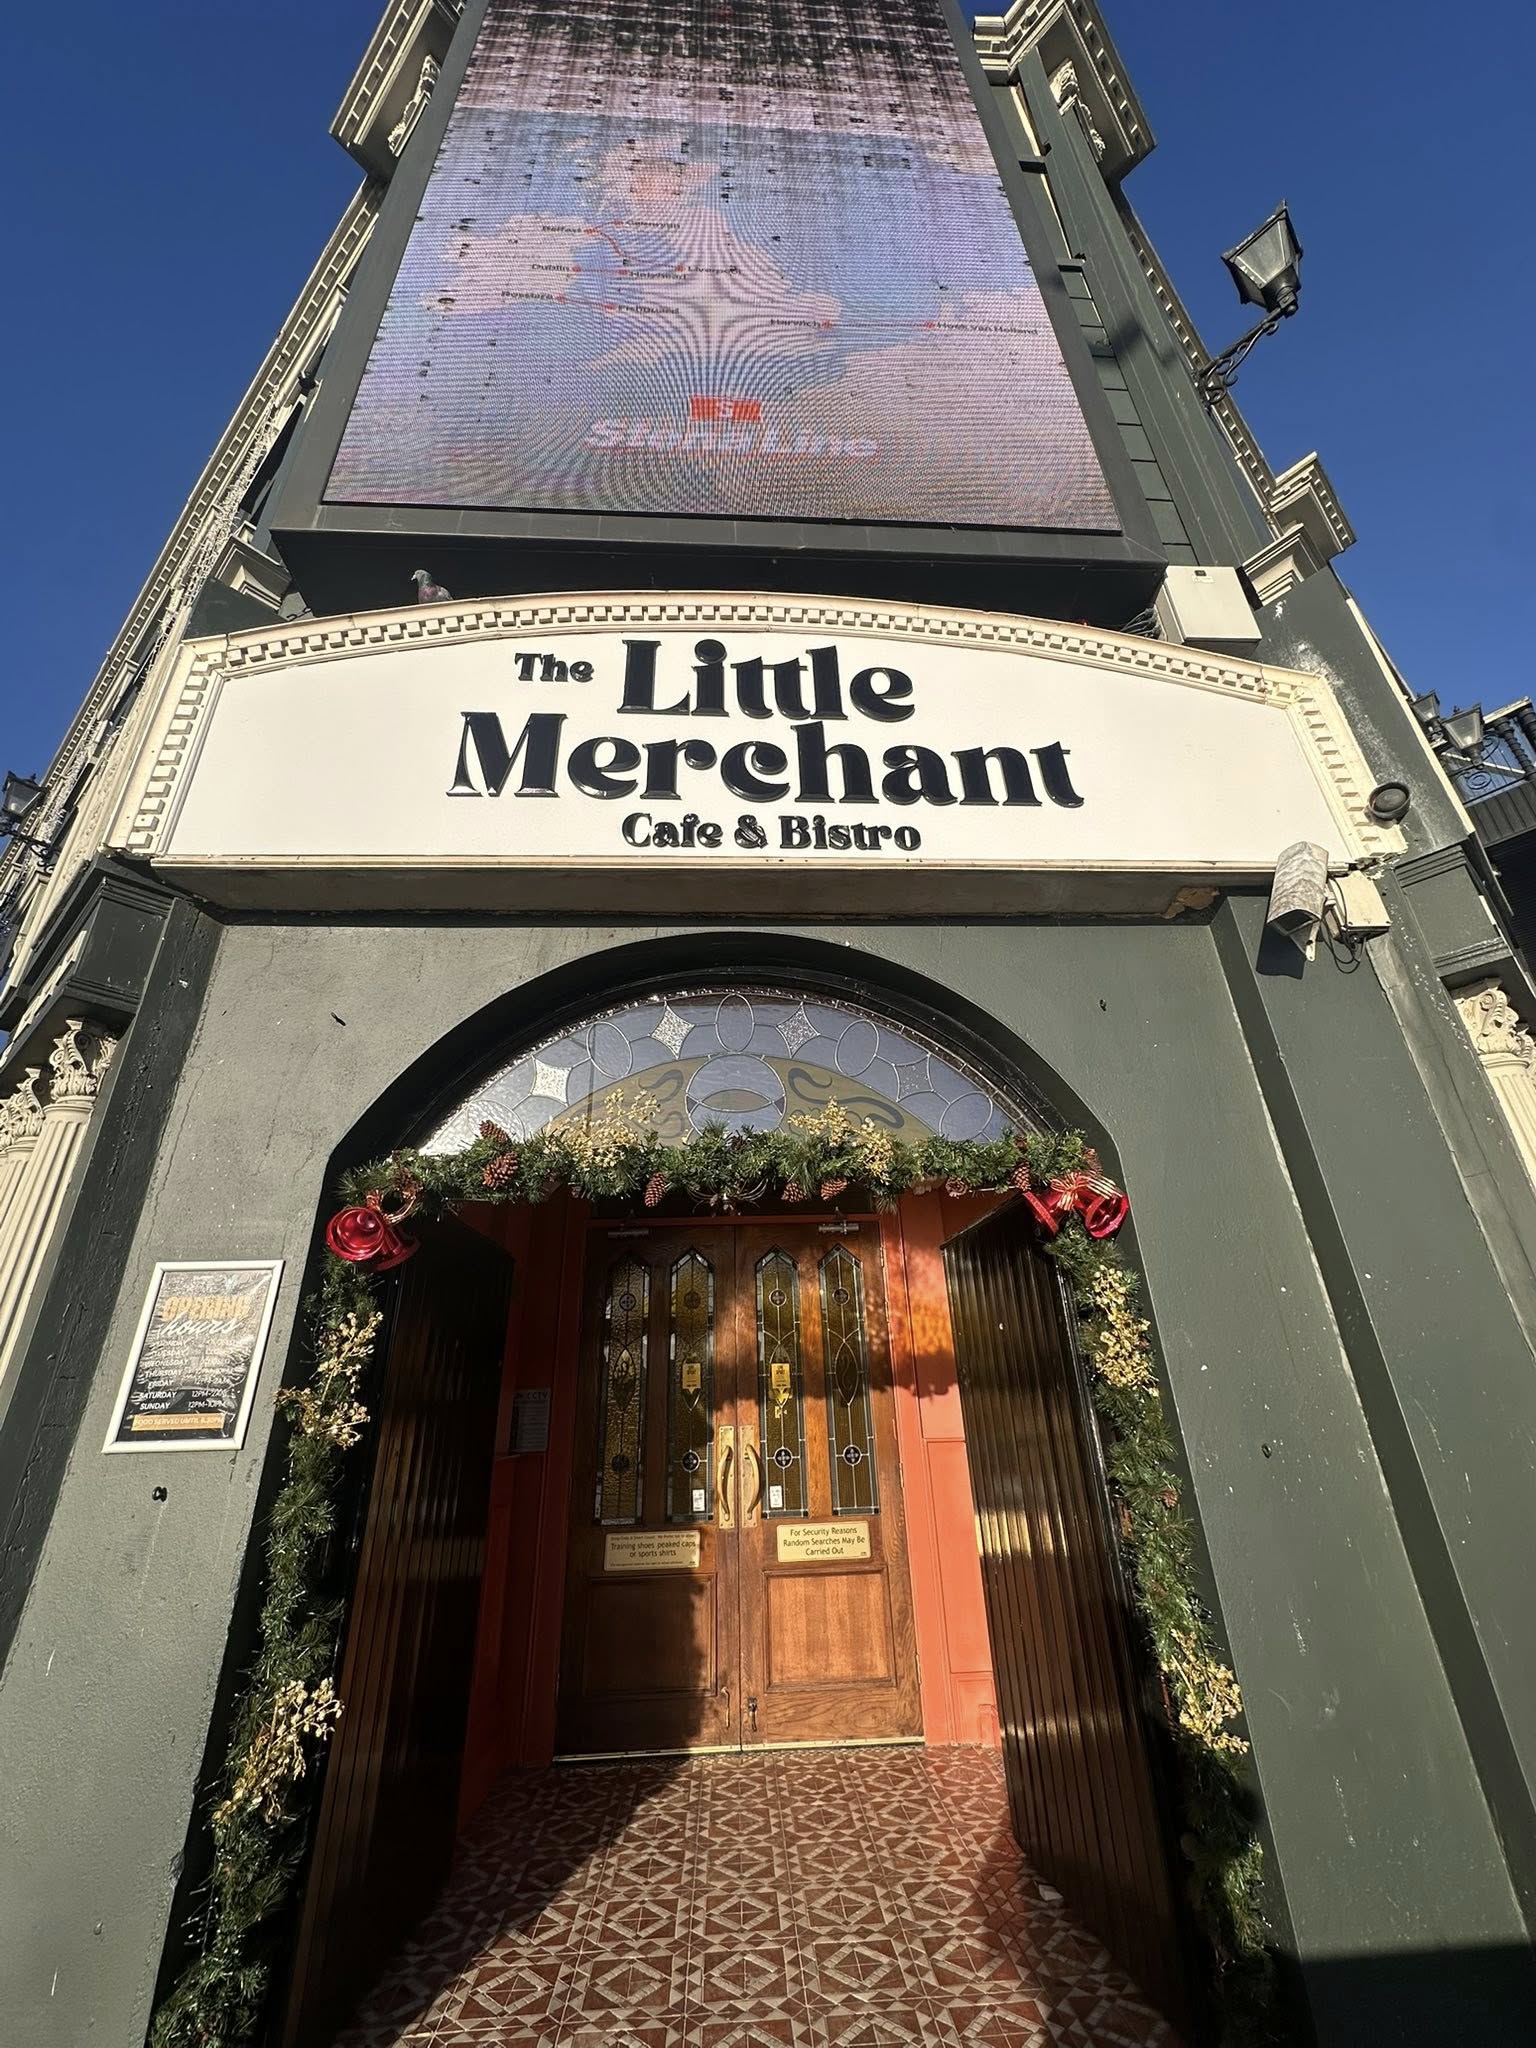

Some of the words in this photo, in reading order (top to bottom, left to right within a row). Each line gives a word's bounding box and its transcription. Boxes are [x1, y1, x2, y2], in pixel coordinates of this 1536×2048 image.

[542, 225, 582, 233] Belfast
[531, 263, 571, 272] Dublin
[769, 318, 822, 329] Harwich
[995, 325, 1040, 336] Holland
[514, 652, 595, 683] The
[616, 638, 916, 722] Little
[446, 721, 1085, 808] Merchant
[622, 812, 724, 850] Cafe
[734, 814, 768, 850] &
[780, 814, 922, 851] Bistro
[161, 1312, 243, 1336] hours
[145, 1368, 182, 1378] THURSDAY
[140, 1390, 178, 1400] SATURDAY
[140, 1402, 171, 1411] SUNDAY
[790, 1528, 801, 1537] For
[802, 1527, 830, 1537] Security
[831, 1526, 858, 1535] Reasons
[611, 1542, 636, 1551] Training
[637, 1541, 655, 1549] shoes
[657, 1540, 680, 1549] peaked
[681, 1540, 696, 1549] caps
[783, 1538, 810, 1548] Random
[811, 1537, 841, 1546] Searches
[841, 1536, 855, 1545] May
[856, 1535, 866, 1544] Be
[638, 1550, 657, 1559] sports
[659, 1549, 677, 1557] shirts
[805, 1546, 831, 1556] Carried
[831, 1546, 845, 1555] Out
